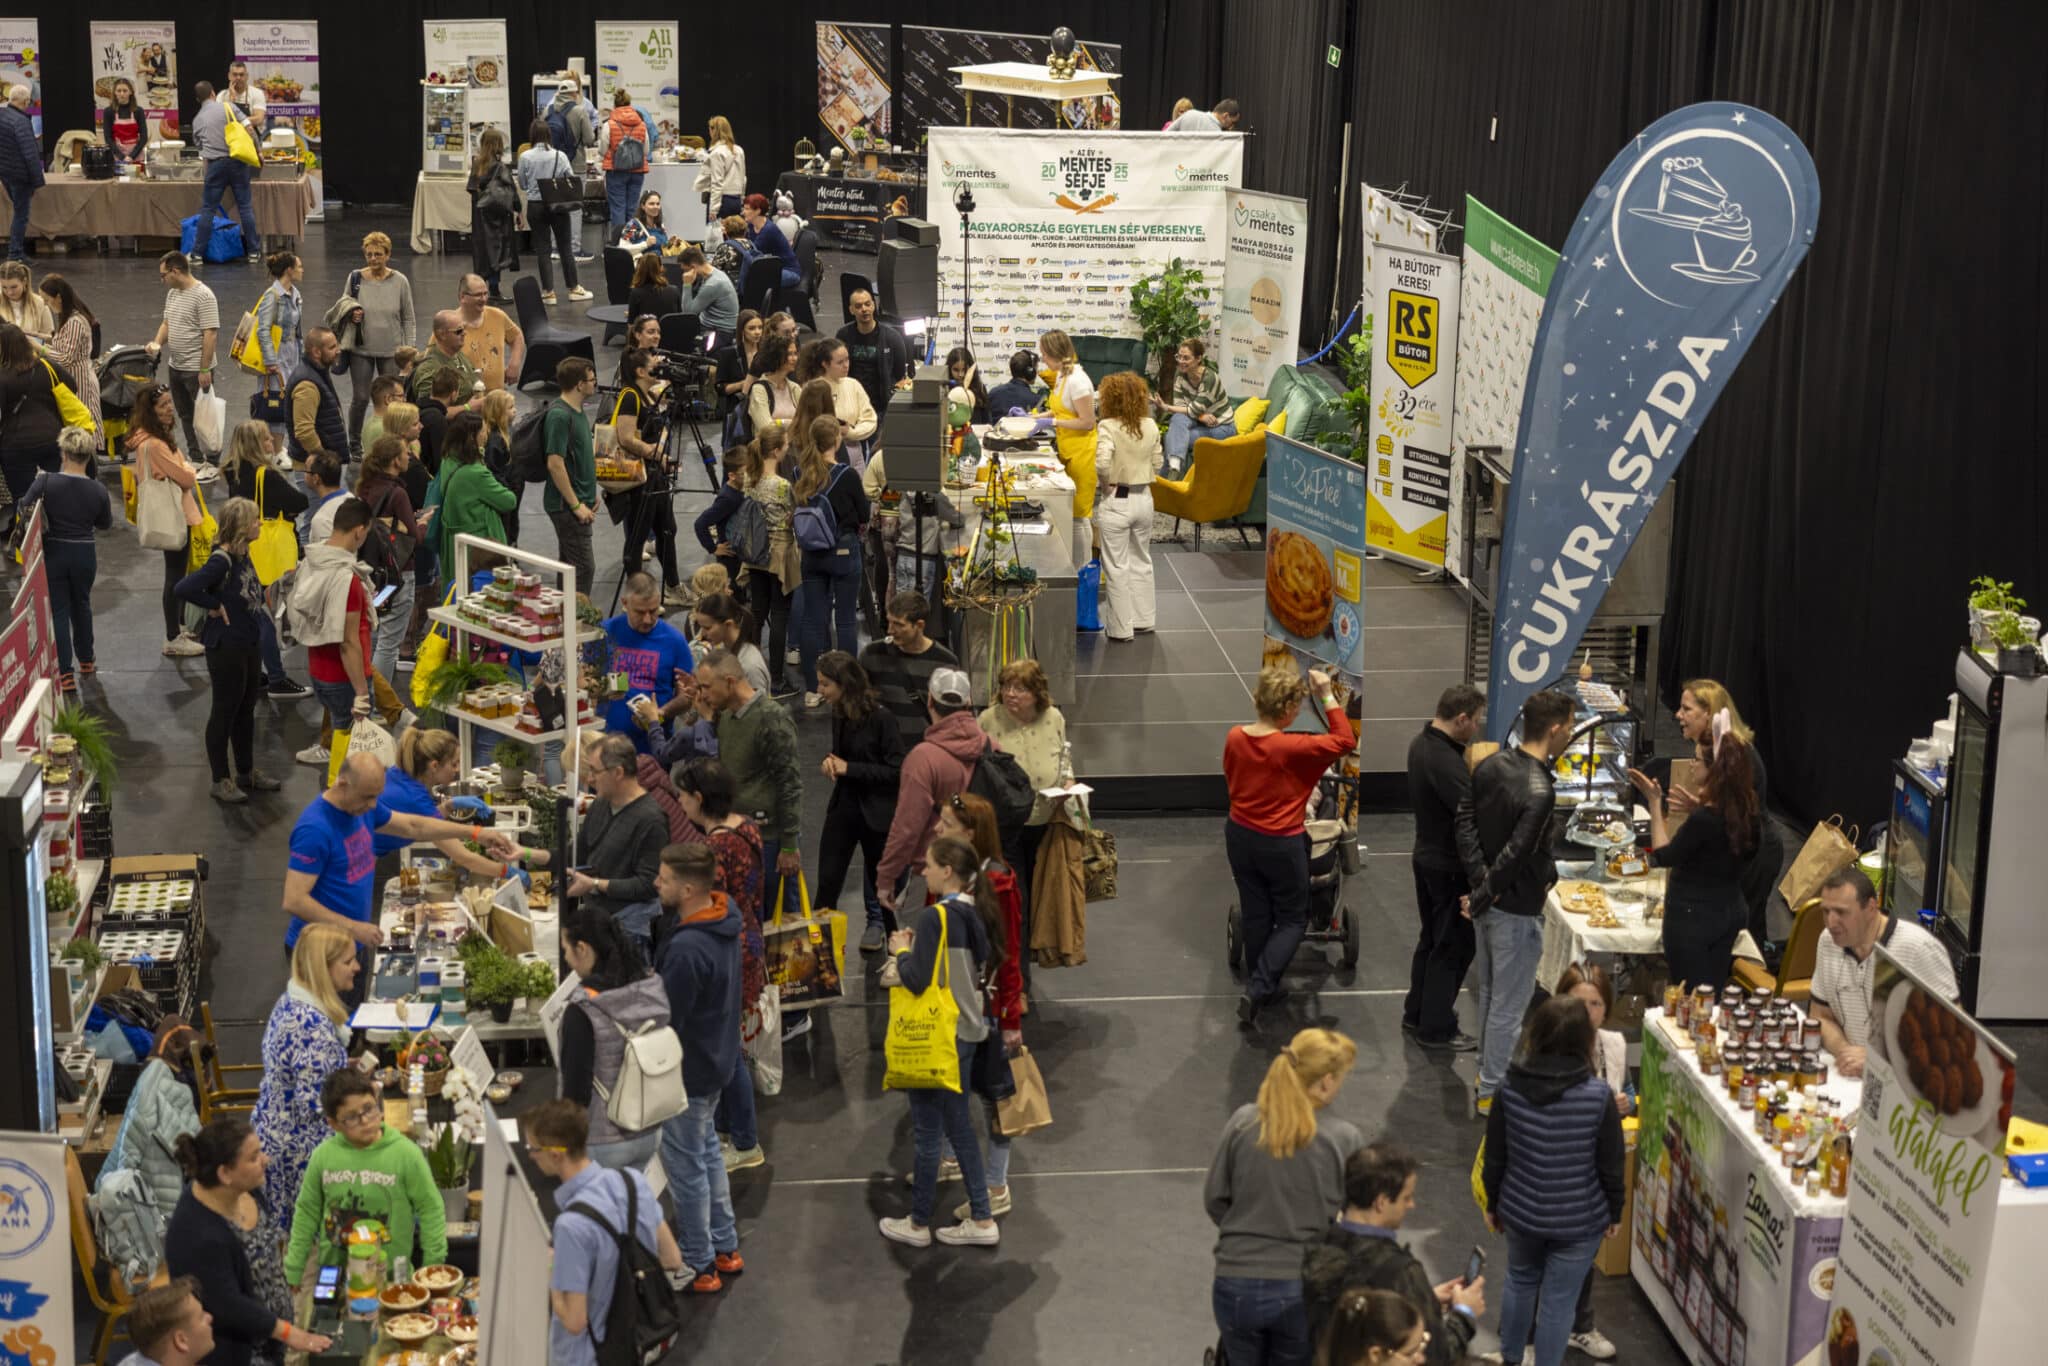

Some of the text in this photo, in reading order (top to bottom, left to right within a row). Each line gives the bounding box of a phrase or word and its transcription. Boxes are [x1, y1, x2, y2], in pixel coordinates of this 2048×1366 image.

[648, 28, 671, 45] All
[1087, 148, 1096, 157] ÉV
[955, 169, 997, 179] mentes
[1041, 157, 1129, 178] 20 MENTES 25
[1065, 171, 1106, 188] SÉFJE
[1189, 173, 1229, 182] mentes
[1250, 208, 1276, 221] csaka
[960, 221, 1206, 235] MAGYARORSZÁG EGYETLEN SÉF VERSENYE.
[1249, 219, 1295, 236] mentes
[1231, 245, 1293, 262] MENTES KÖZÖSSÉGE
[1232, 237, 1294, 254] MAGYARORSZÁG
[1389, 256, 1442, 278] HA BÚTORT
[1397, 274, 1431, 292] KERES!
[1250, 296, 1281, 308] MAGAZIN
[1395, 300, 1432, 340] RS
[1398, 344, 1428, 360] BÚTOR
[1394, 389, 1417, 420] 32
[1418, 394, 1437, 413] éve
[1508, 336, 1729, 684] CUKRÁSZDA
[322, 1169, 397, 1186] ANGRY BIRDS
